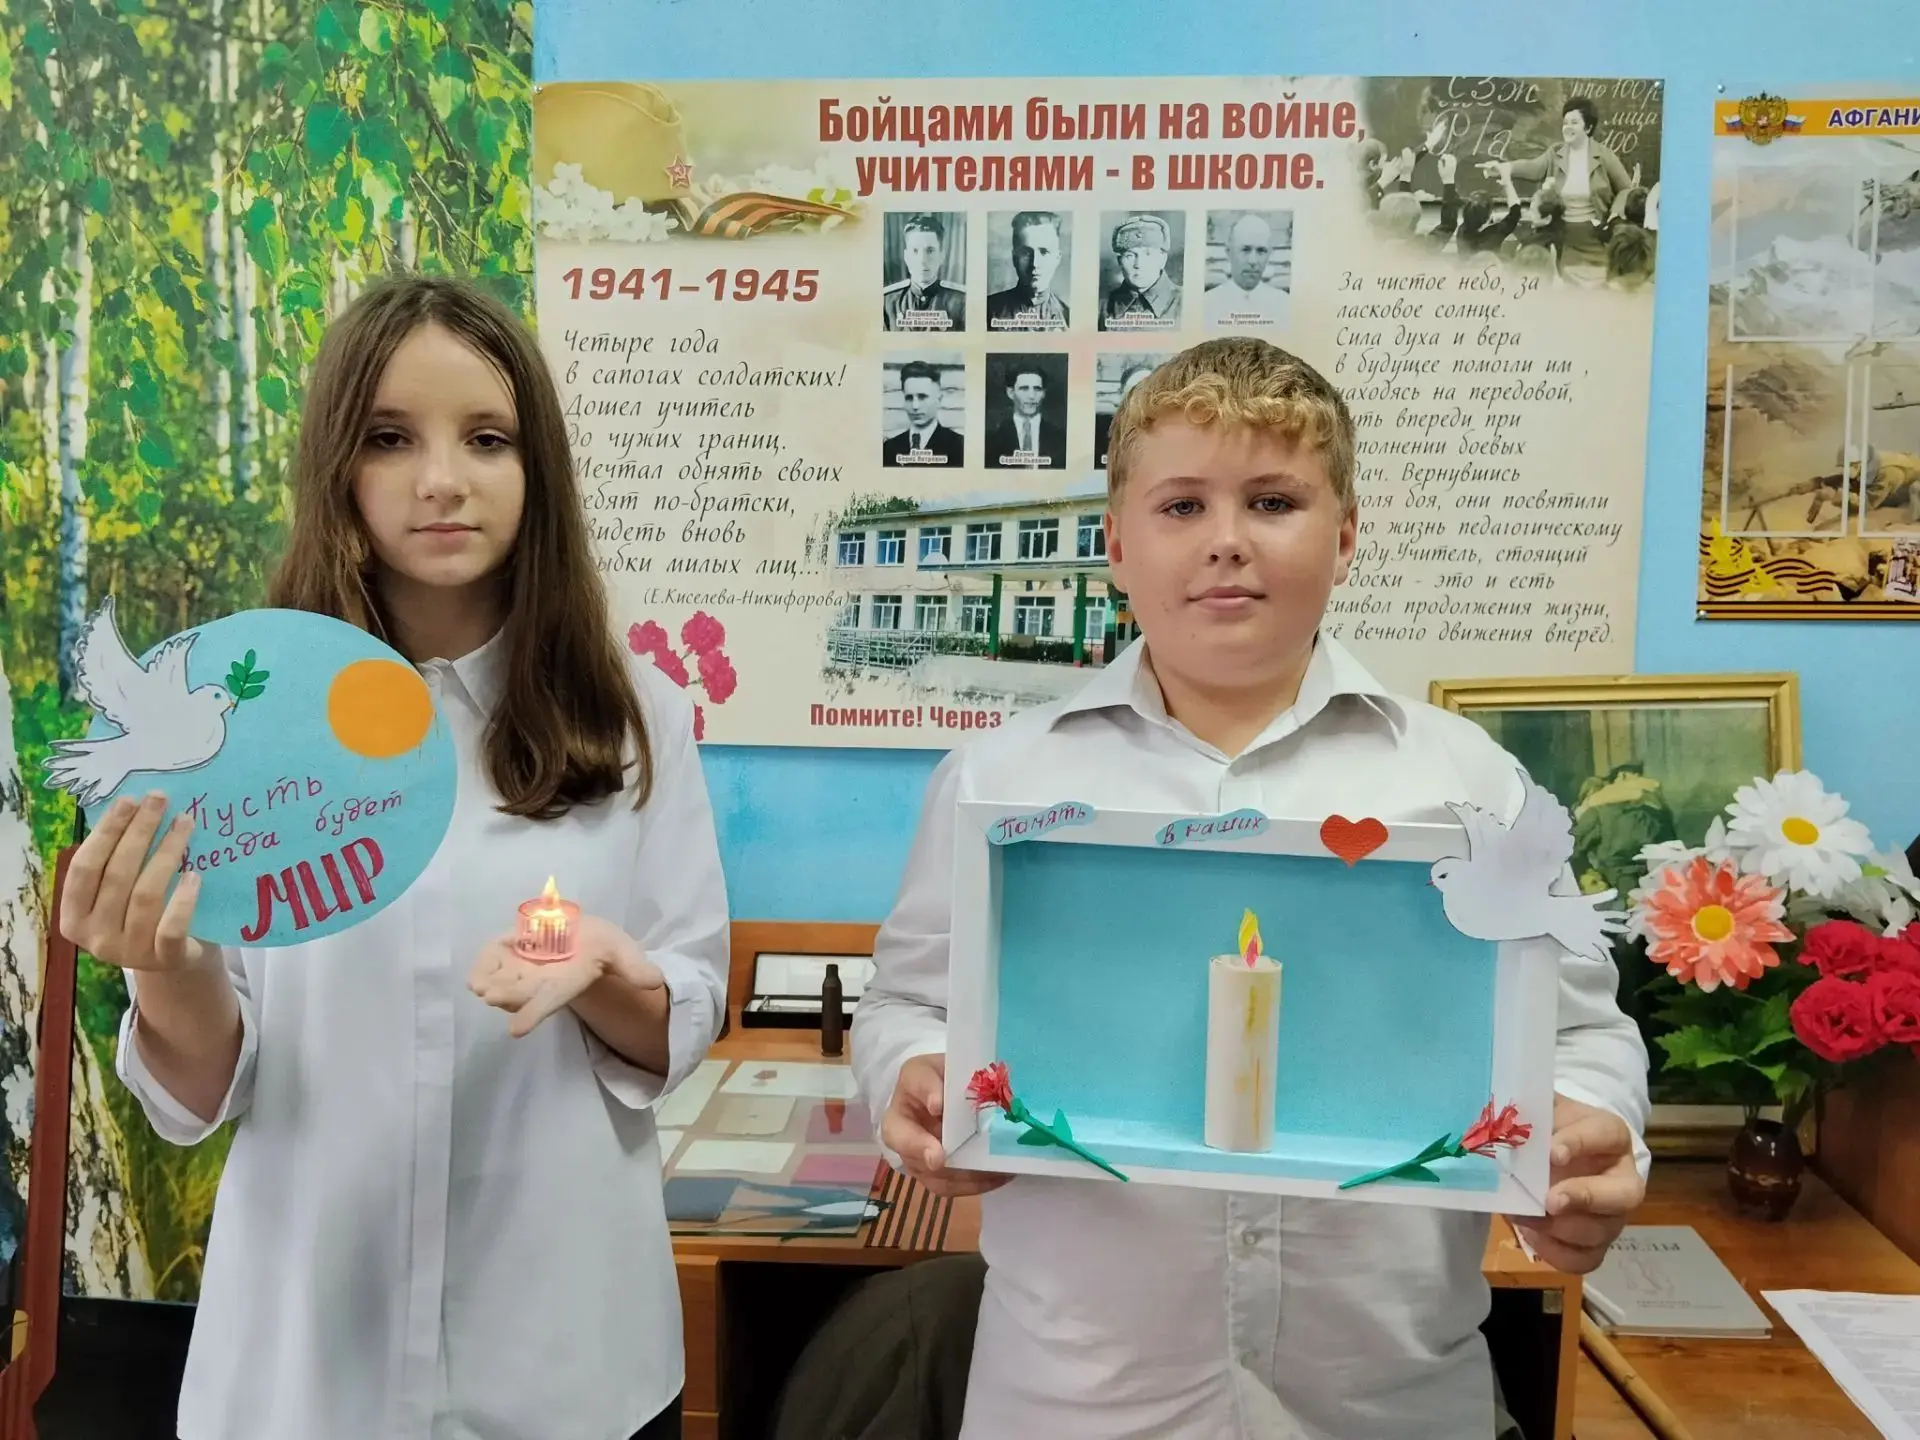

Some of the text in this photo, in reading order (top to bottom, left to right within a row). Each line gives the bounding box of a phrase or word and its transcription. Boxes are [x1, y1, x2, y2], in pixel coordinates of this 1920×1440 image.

[820, 92, 1365, 148] Бойцами были на войне,
[855, 155, 1094, 196] учителями
[1132, 155, 1155, 190] в
[1168, 153, 1324, 190] школе.
[1337, 265, 1539, 299] За чистое небо, за
[1336, 298, 1505, 322] ласковое солнце.
[564, 328, 719, 363] Четыре года
[1336, 325, 1521, 356] Сила духа и вера
[565, 361, 848, 387] в сапогах солдатских!
[1335, 353, 1346, 373] в
[1357, 348, 1440, 383] будущее
[1452, 358, 1533, 374] помогли
[1545, 358, 1572, 373] им
[1433, 386, 1456, 401] на
[1469, 379, 1573, 409] передовой,
[565, 393, 755, 429] Дошел учитель
[1396, 407, 1473, 437] впереди
[1485, 412, 1522, 436] при
[569, 423, 786, 460] до чужих границ.
[1459, 430, 1528, 455] боевых
[678, 451, 763, 481] обнять
[777, 458, 844, 482] своих
[1401, 461, 1521, 491] Вернувшись
[653, 482, 796, 521] по-братски,
[1405, 483, 1442, 512] боя,
[1455, 494, 1491, 509] они
[1503, 490, 1609, 509] посвятили
[682, 519, 746, 543] вновь
[1388, 520, 1446, 543] жизнь
[1458, 515, 1624, 546] педагогическому
[666, 557, 741, 574] милых
[1495, 545, 1588, 568] стоящий
[1349, 567, 1403, 588] доски
[1434, 572, 1473, 590] это
[1486, 576, 1497, 588] и
[1509, 572, 1555, 590] есть
[1404, 595, 1532, 623] продолжения
[1544, 601, 1610, 625] жизни,
[1354, 620, 1426, 641] вечного
[1439, 622, 1533, 642] движения
[811, 703, 1002, 730] Помните! Через
[315, 790, 403, 836] будет
[998, 803, 1087, 843] Память
[1186, 816, 1264, 835] наших
[240, 837, 384, 942] МИР
